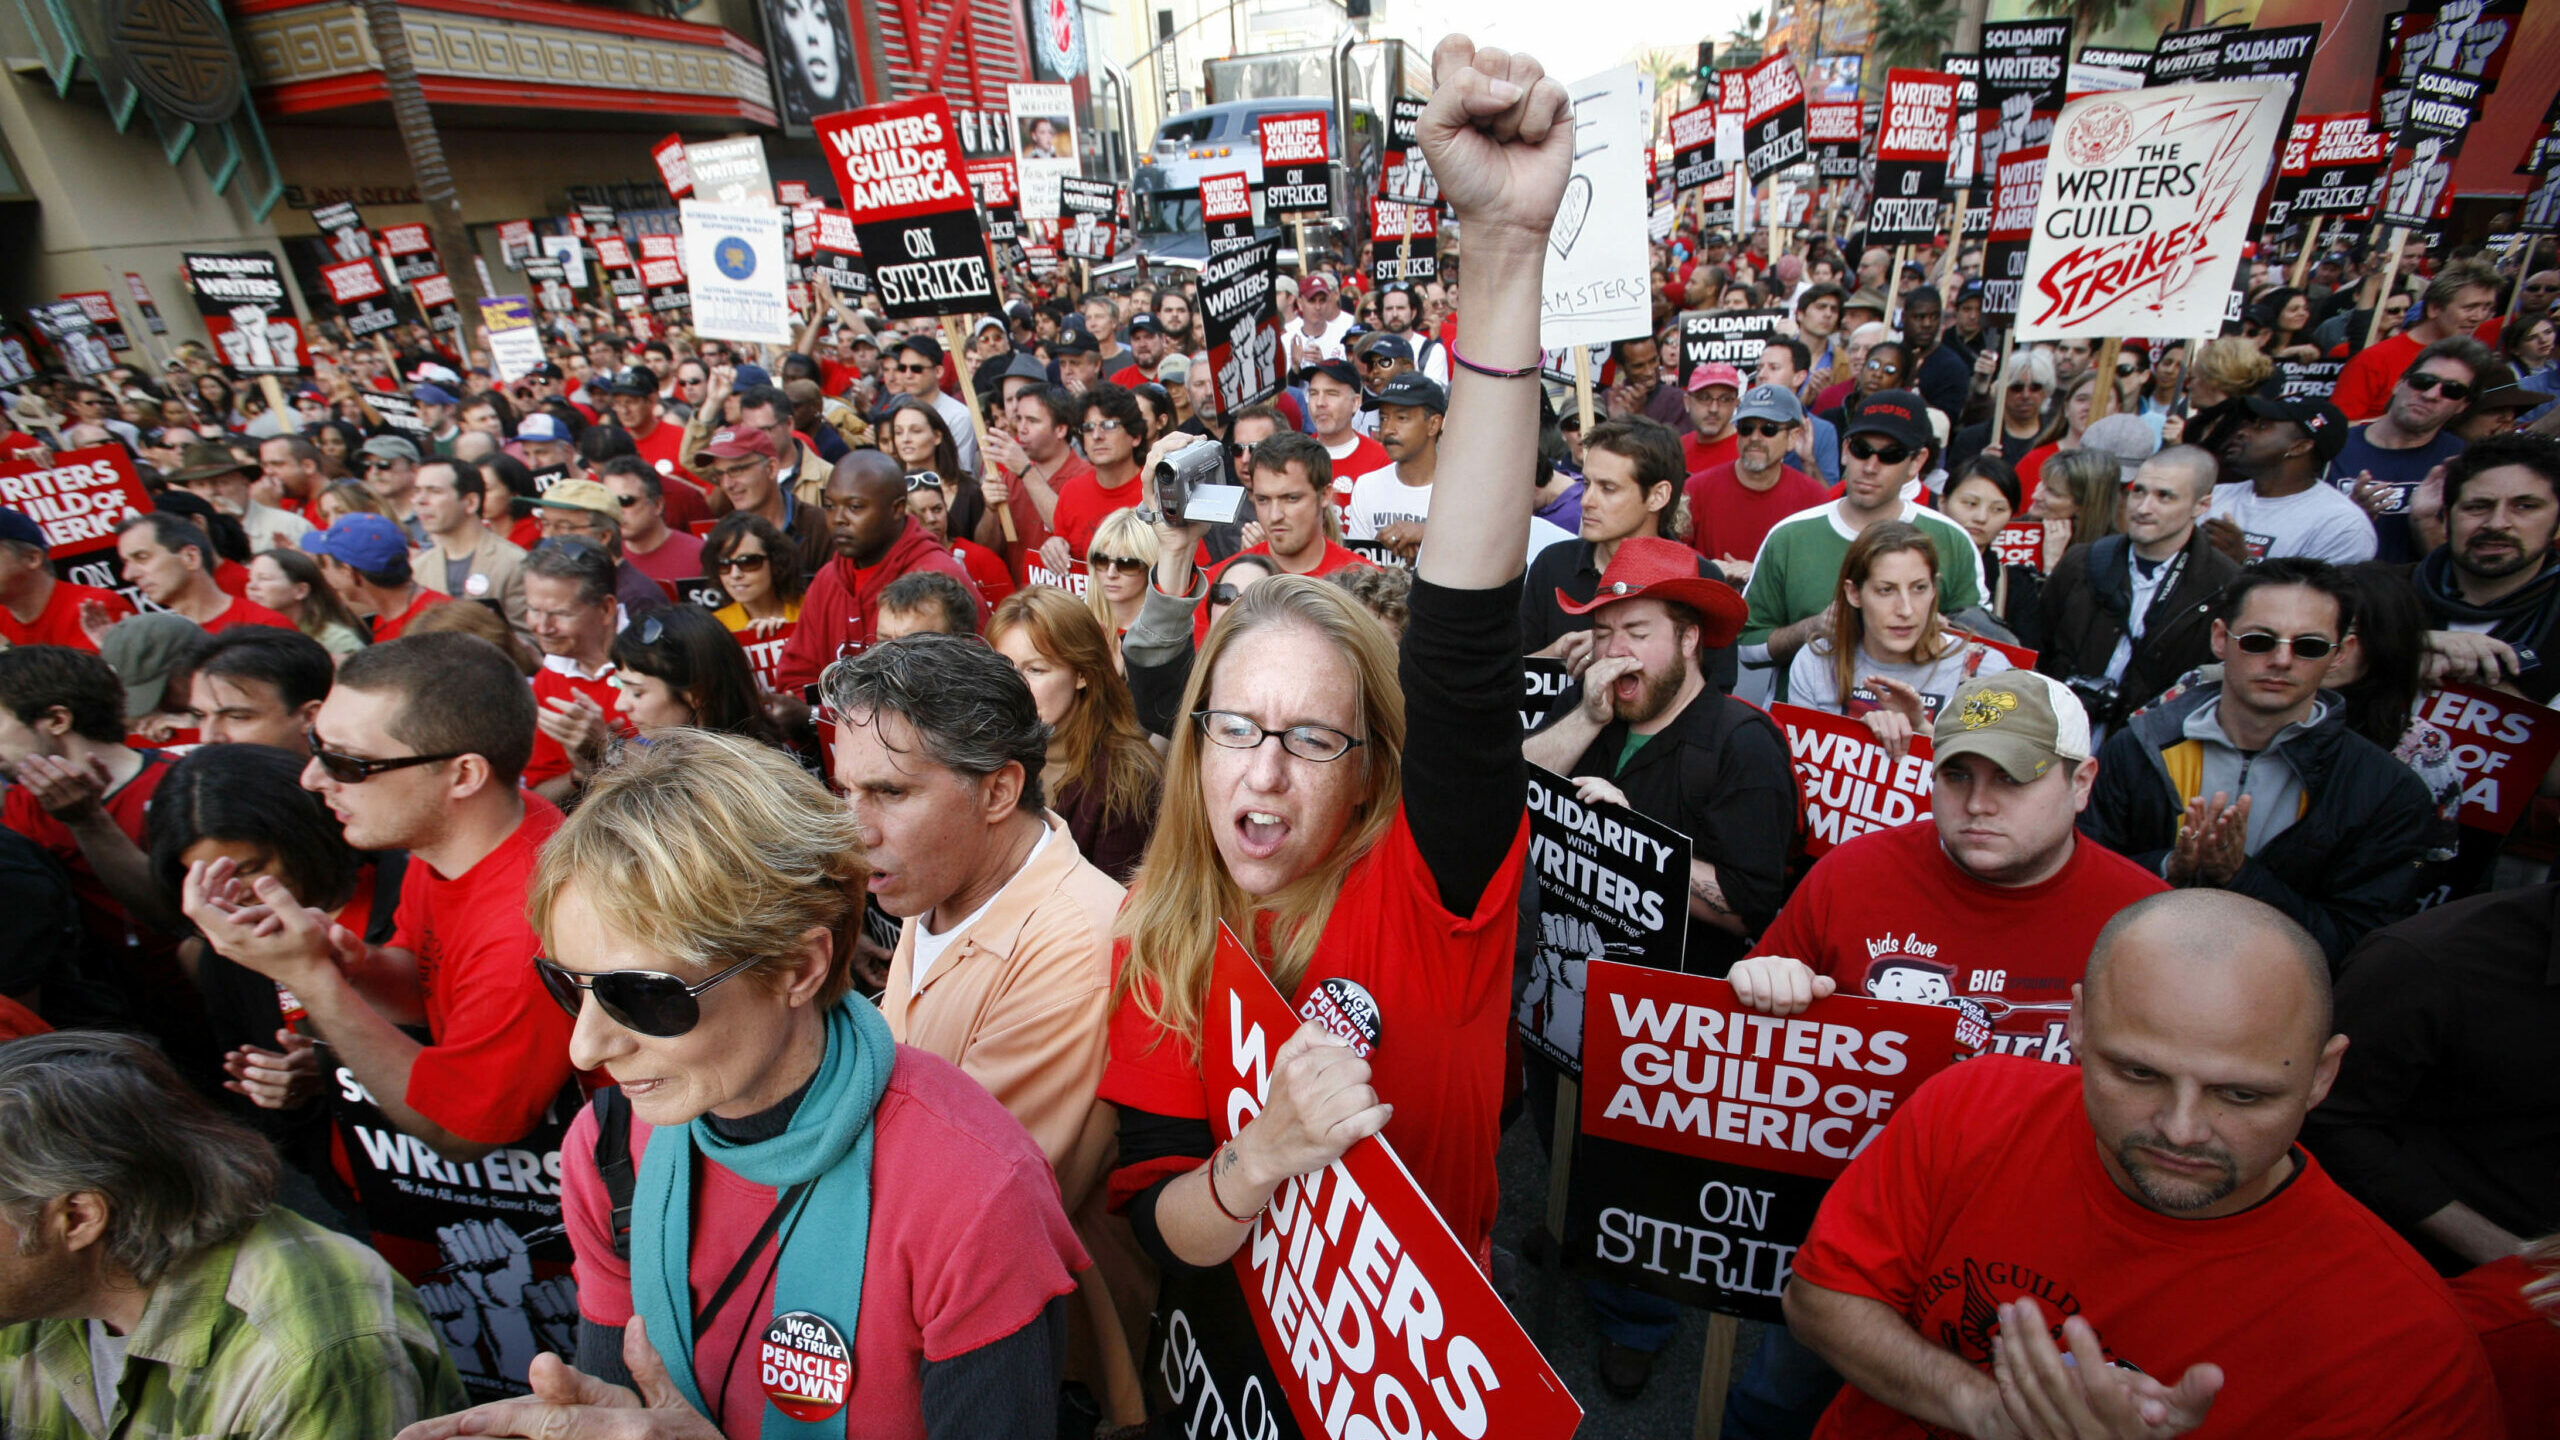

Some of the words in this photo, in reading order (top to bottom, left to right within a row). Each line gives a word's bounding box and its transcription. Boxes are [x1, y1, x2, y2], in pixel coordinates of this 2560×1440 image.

[1985, 27, 2066, 49] SOLIDARITY
[2223, 35, 2313, 64] SOLIDARITY
[1984, 56, 2061, 80] WRITERS
[2081, 50, 2152, 68] SOLIDARITY
[1891, 81, 1952, 107] WRITERS
[2417, 73, 2480, 99] SOLIDARITY
[1747, 80, 1802, 122] AMERICA
[1809, 106, 1858, 118] WRITERS
[2411, 99, 2471, 129] WRITERS
[1263, 118, 1320, 136] WRITERS
[1890, 106, 1936, 127] GUILD
[1936, 112, 1948, 126] OF
[828, 113, 943, 157] WRITERS
[1267, 135, 1304, 149] GUILD
[1305, 135, 1319, 145] OF
[1763, 119, 1779, 142] ON
[1808, 126, 1858, 139] AMERICA
[1883, 128, 1948, 151] AMERICA
[2361, 134, 2381, 144] OF
[847, 148, 920, 183] GUILD
[922, 150, 947, 171] OF
[1265, 146, 1324, 162] AMERICA
[1747, 127, 1804, 178] STRIKE
[2137, 144, 2181, 162] THE
[694, 158, 761, 182] WRITERS
[1286, 169, 1303, 184] ON
[1677, 160, 1723, 187] STRIKE
[1901, 170, 1921, 195] ON
[2057, 163, 2200, 203] WRITERS
[2322, 170, 2345, 187] ON
[854, 170, 964, 211] AMERICA
[1063, 178, 1115, 194] SOLIDARITY
[1202, 177, 1244, 194] WRITERS
[1205, 190, 1235, 205] GUILD
[1235, 190, 1245, 201] OF
[1267, 184, 1327, 208] STRIKE
[1999, 185, 2041, 208] GUILD
[1064, 193, 1113, 210] WRITERS
[1206, 200, 1249, 217] AMERICA
[1870, 199, 1937, 232] STRIKE
[2046, 204, 2152, 239] GUILD
[1223, 223, 1236, 237] ON
[1376, 221, 1432, 237] AMEICA
[903, 227, 936, 258] ON
[188, 256, 275, 275] SOLIDARITY
[1202, 244, 1273, 287] SOLIDARITY
[2007, 251, 2026, 276] ON
[195, 277, 283, 299] WRITERS
[877, 256, 991, 305] STRIKE
[1205, 269, 1270, 317] WRITERS
[1687, 315, 1782, 334] SOLIDARITY
[0, 459, 120, 504] RITERS
[92, 489, 128, 509] OF
[2006, 548, 2035, 560] OF
[69, 560, 118, 589] ON
[2451, 744, 2512, 774] OF
[1527, 779, 1674, 874] OLIDARITY
[1565, 831, 1598, 858] WITH
[1552, 883, 1565, 898] All
[1565, 893, 1577, 904] on
[1576, 897, 1591, 911] the
[1591, 904, 1617, 927] Same
[1866, 932, 1899, 959] kids
[1904, 932, 1938, 959] love
[1968, 969, 2007, 992] BIG
[1327, 983, 1344, 1004] ON
[1342, 1002, 1376, 1040] STRIKE
[1342, 983, 1373, 1022] WGA
[1309, 986, 1370, 1059] PENCILS
[1960, 1009, 1992, 1028] STRIKE
[1610, 994, 1909, 1077] WRITERS
[1543, 1042, 1569, 1064] GUILD
[1621, 1044, 1820, 1108] GUILD
[1824, 1084, 1895, 1120] OF
[415, 1184, 436, 1199] Are
[436, 1187, 453, 1202] All
[453, 1192, 469, 1204] on
[470, 1194, 488, 1208] the
[488, 1195, 526, 1212] Same
[1699, 1180, 1776, 1232] ON
[1596, 1206, 1798, 1299] STRIK
[1986, 1261, 2081, 1316] GUILD
[786, 1317, 827, 1343] WGA
[770, 1329, 791, 1346] ON
[795, 1336, 842, 1359] STRIKE
[761, 1343, 848, 1382] PENCILS
[762, 1363, 843, 1404] DOWN
